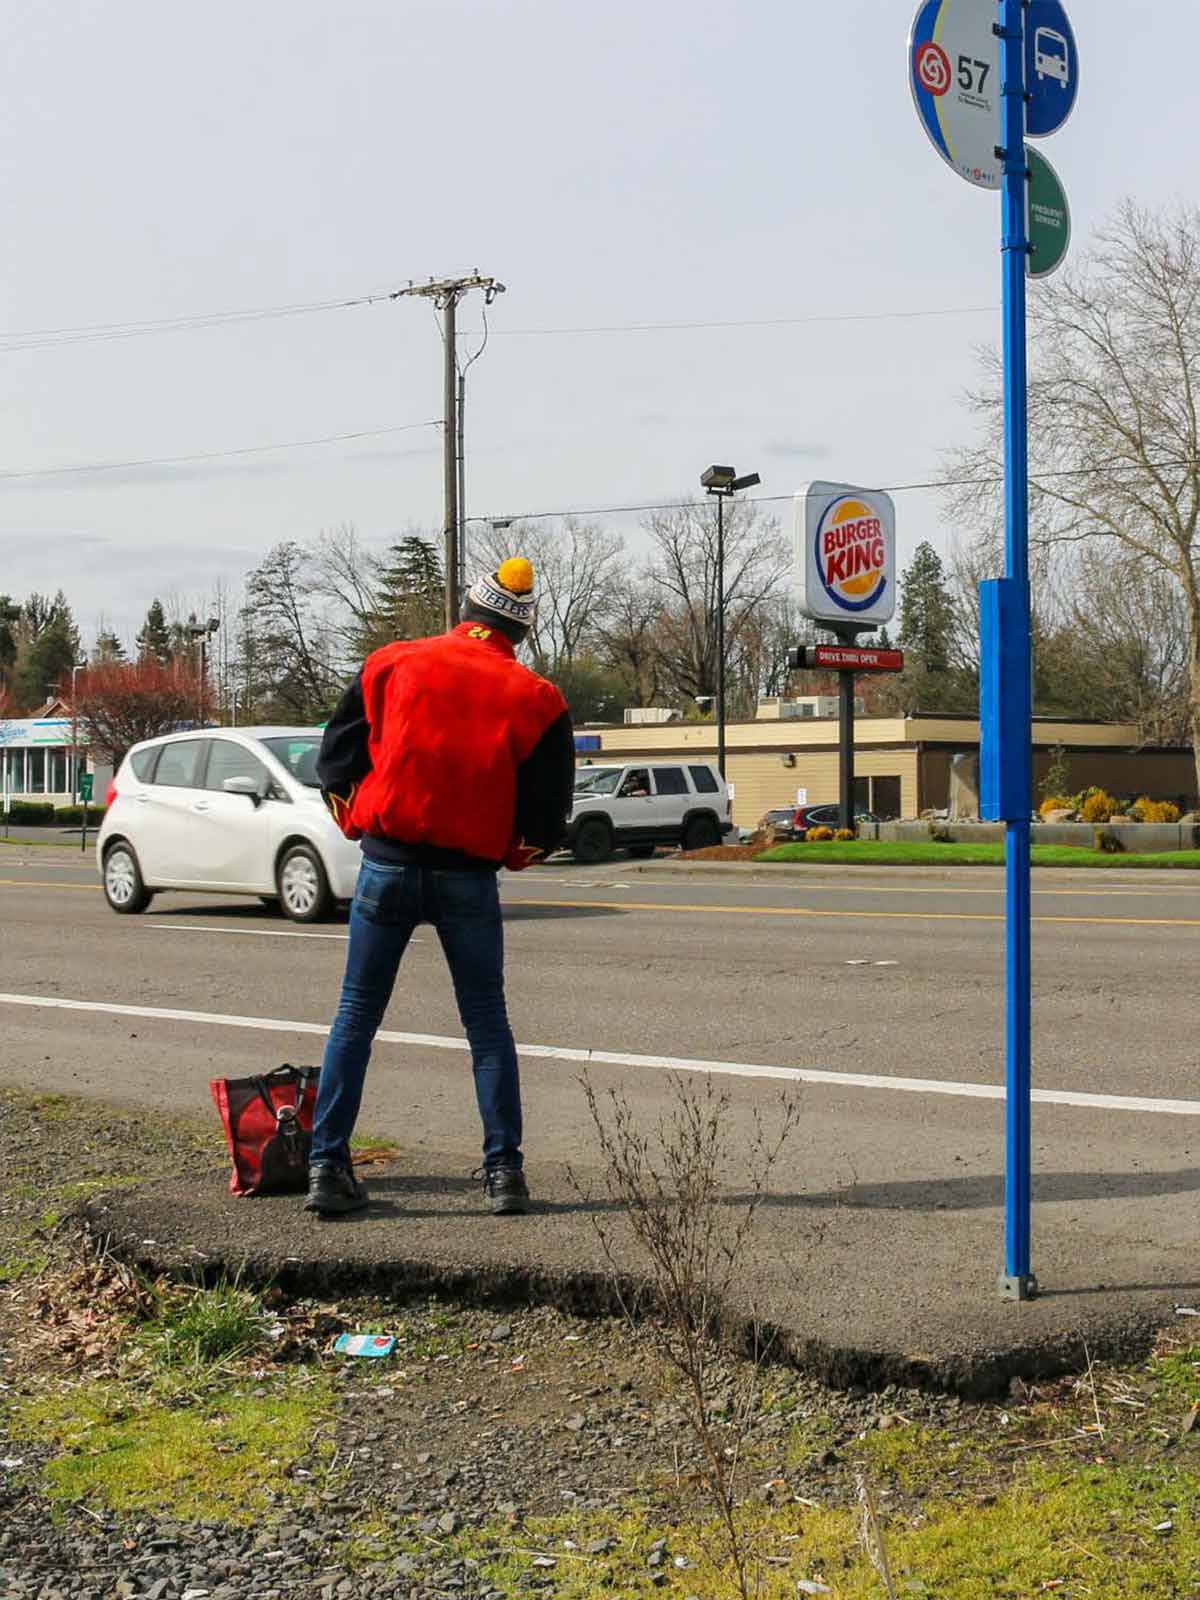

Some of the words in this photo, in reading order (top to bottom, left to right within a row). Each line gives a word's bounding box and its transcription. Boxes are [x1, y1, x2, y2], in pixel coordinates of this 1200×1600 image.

[958, 55, 990, 94] 57
[824, 518, 881, 555] BURGER
[826, 538, 884, 586] KING
[478, 585, 530, 617] STEELERS
[467, 626, 492, 641] 24
